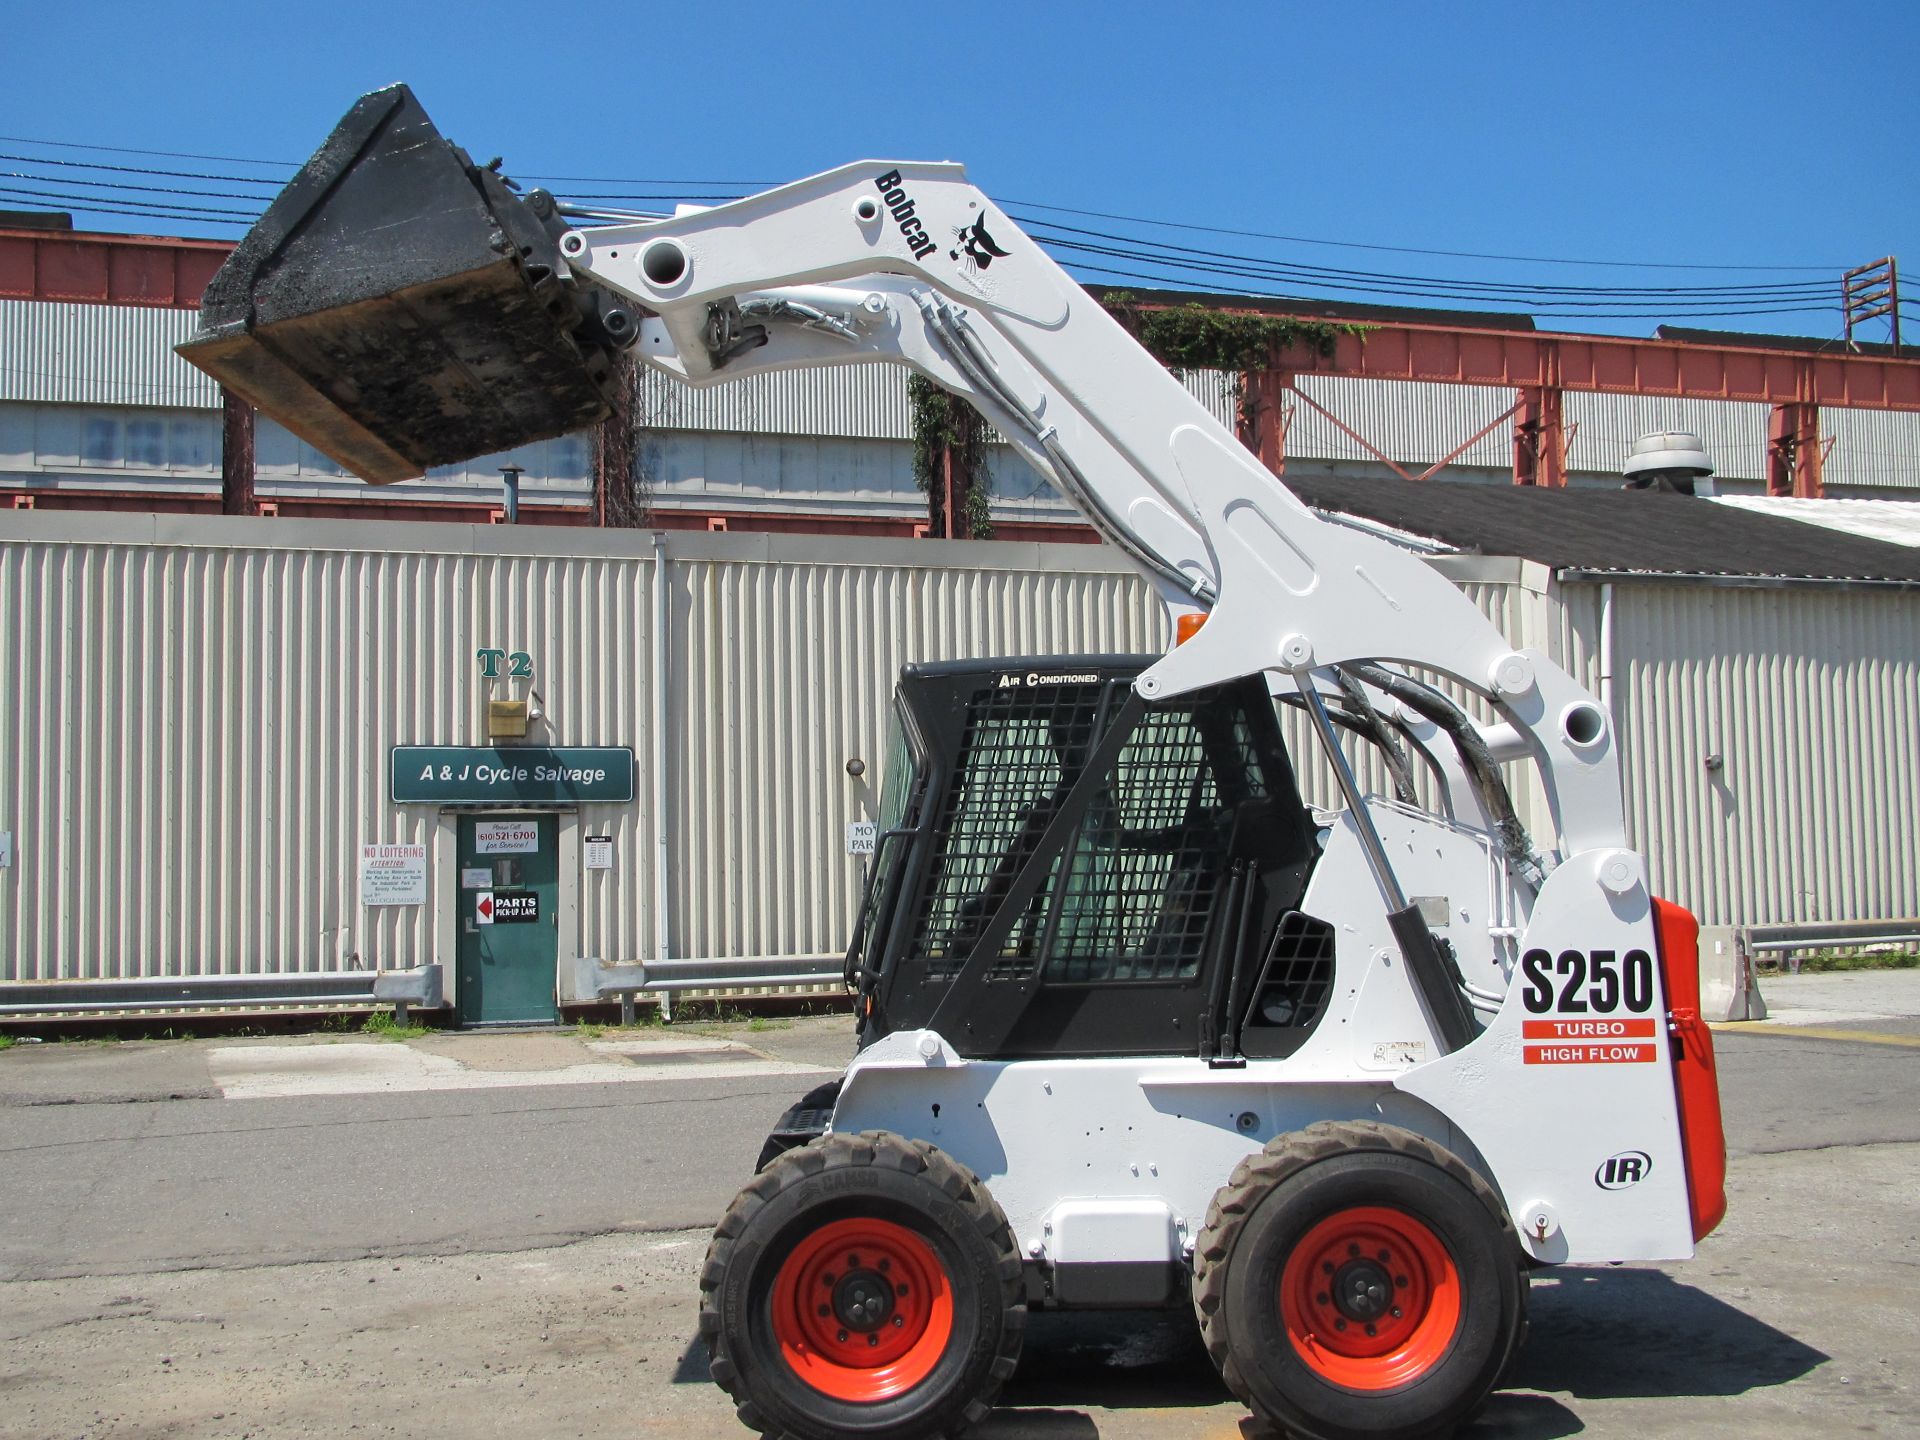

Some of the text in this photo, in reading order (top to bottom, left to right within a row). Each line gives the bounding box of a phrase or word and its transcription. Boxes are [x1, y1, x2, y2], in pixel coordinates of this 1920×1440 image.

[874, 168, 938, 262] Bobcat
[476, 647, 534, 679] T2
[419, 764, 606, 785] A & J Cycle Salvage
[495, 831, 536, 840] 521-6700
[364, 847, 424, 858] NO LOITERING
[485, 842, 497, 851] for
[495, 897, 537, 908] PARTS
[495, 907, 537, 916] PICK-UP LANE
[1521, 948, 1653, 1014] S250
[1553, 1022, 1625, 1036] TURBO
[1540, 1047, 1639, 1061] HIGH FLOW
[1604, 1157, 1643, 1184] IR
